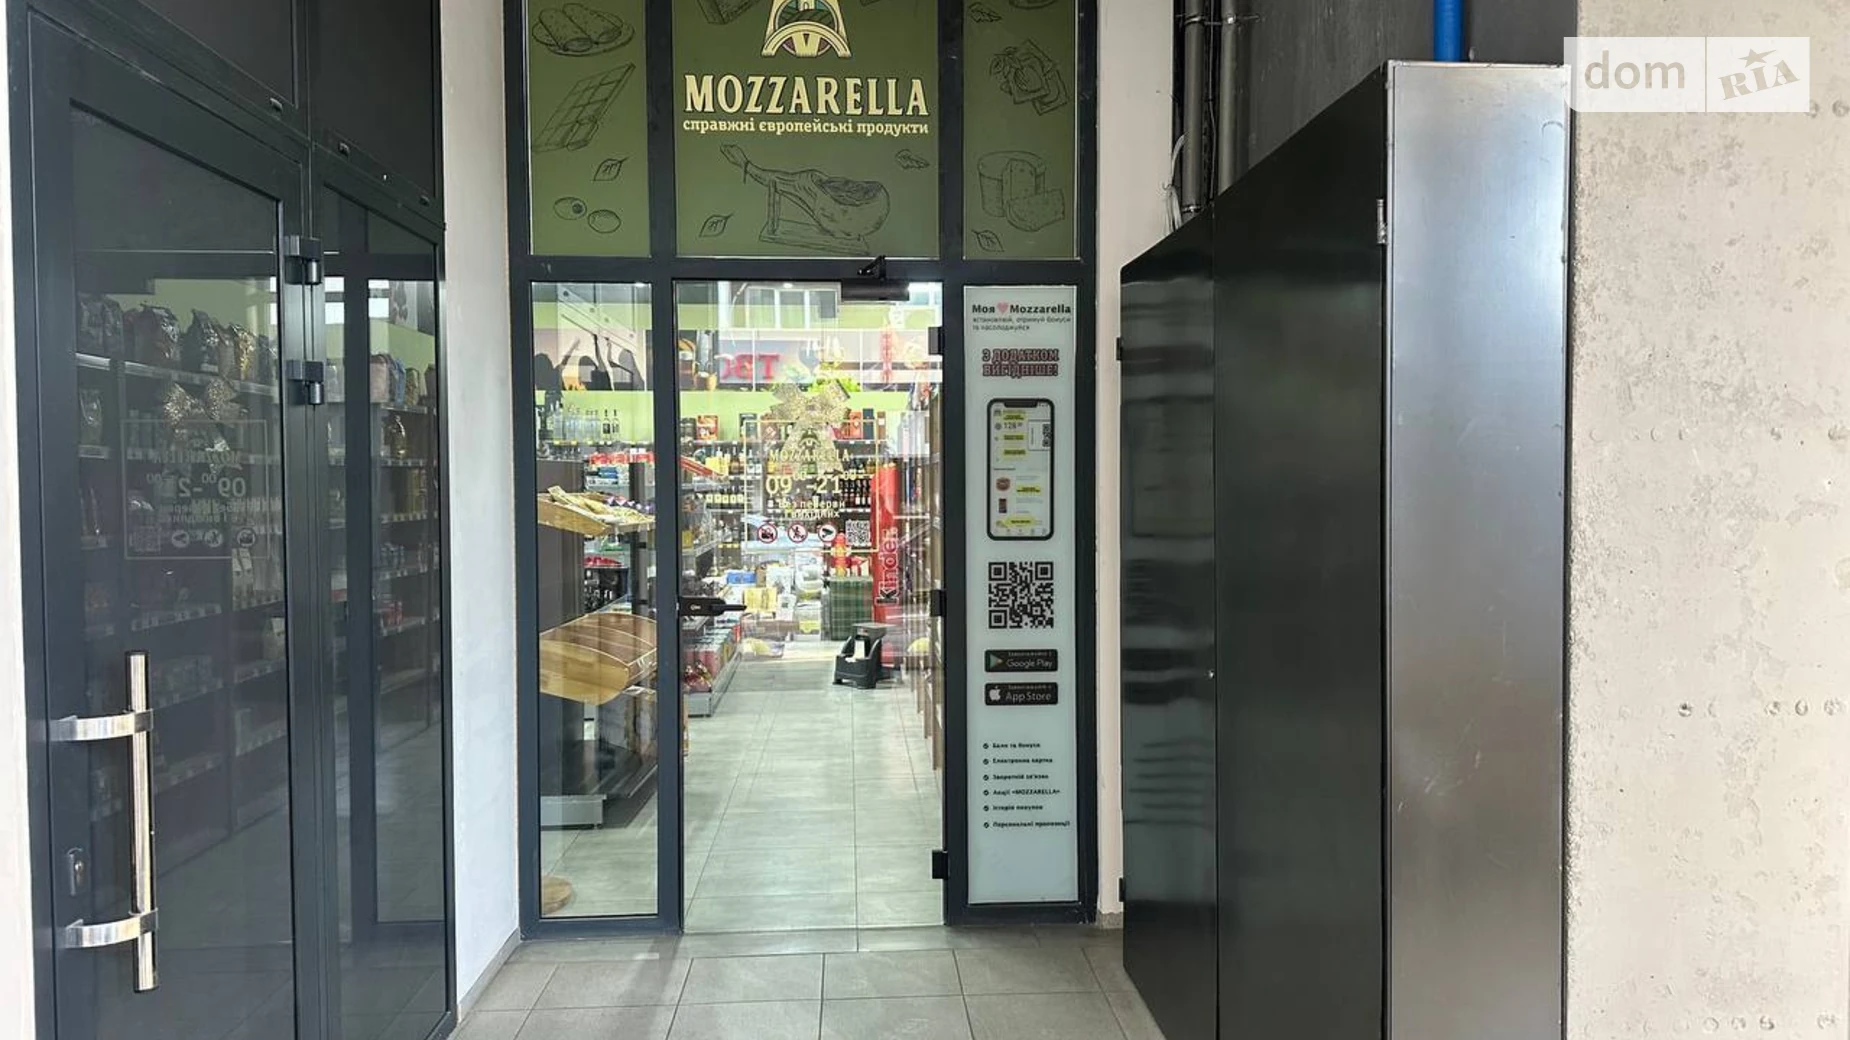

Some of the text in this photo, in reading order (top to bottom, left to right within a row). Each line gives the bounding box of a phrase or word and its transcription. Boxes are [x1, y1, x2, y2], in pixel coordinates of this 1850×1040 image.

[684, 74, 929, 117] MOZZARELLA
[683, 117, 929, 137] справжні європейські продукти
[972, 303, 1072, 314] Моя Mozzarella
[992, 348, 1060, 363] ДОДАТКОМ
[1006, 658, 1053, 670] Google Play
[1005, 690, 1052, 704] App Store
